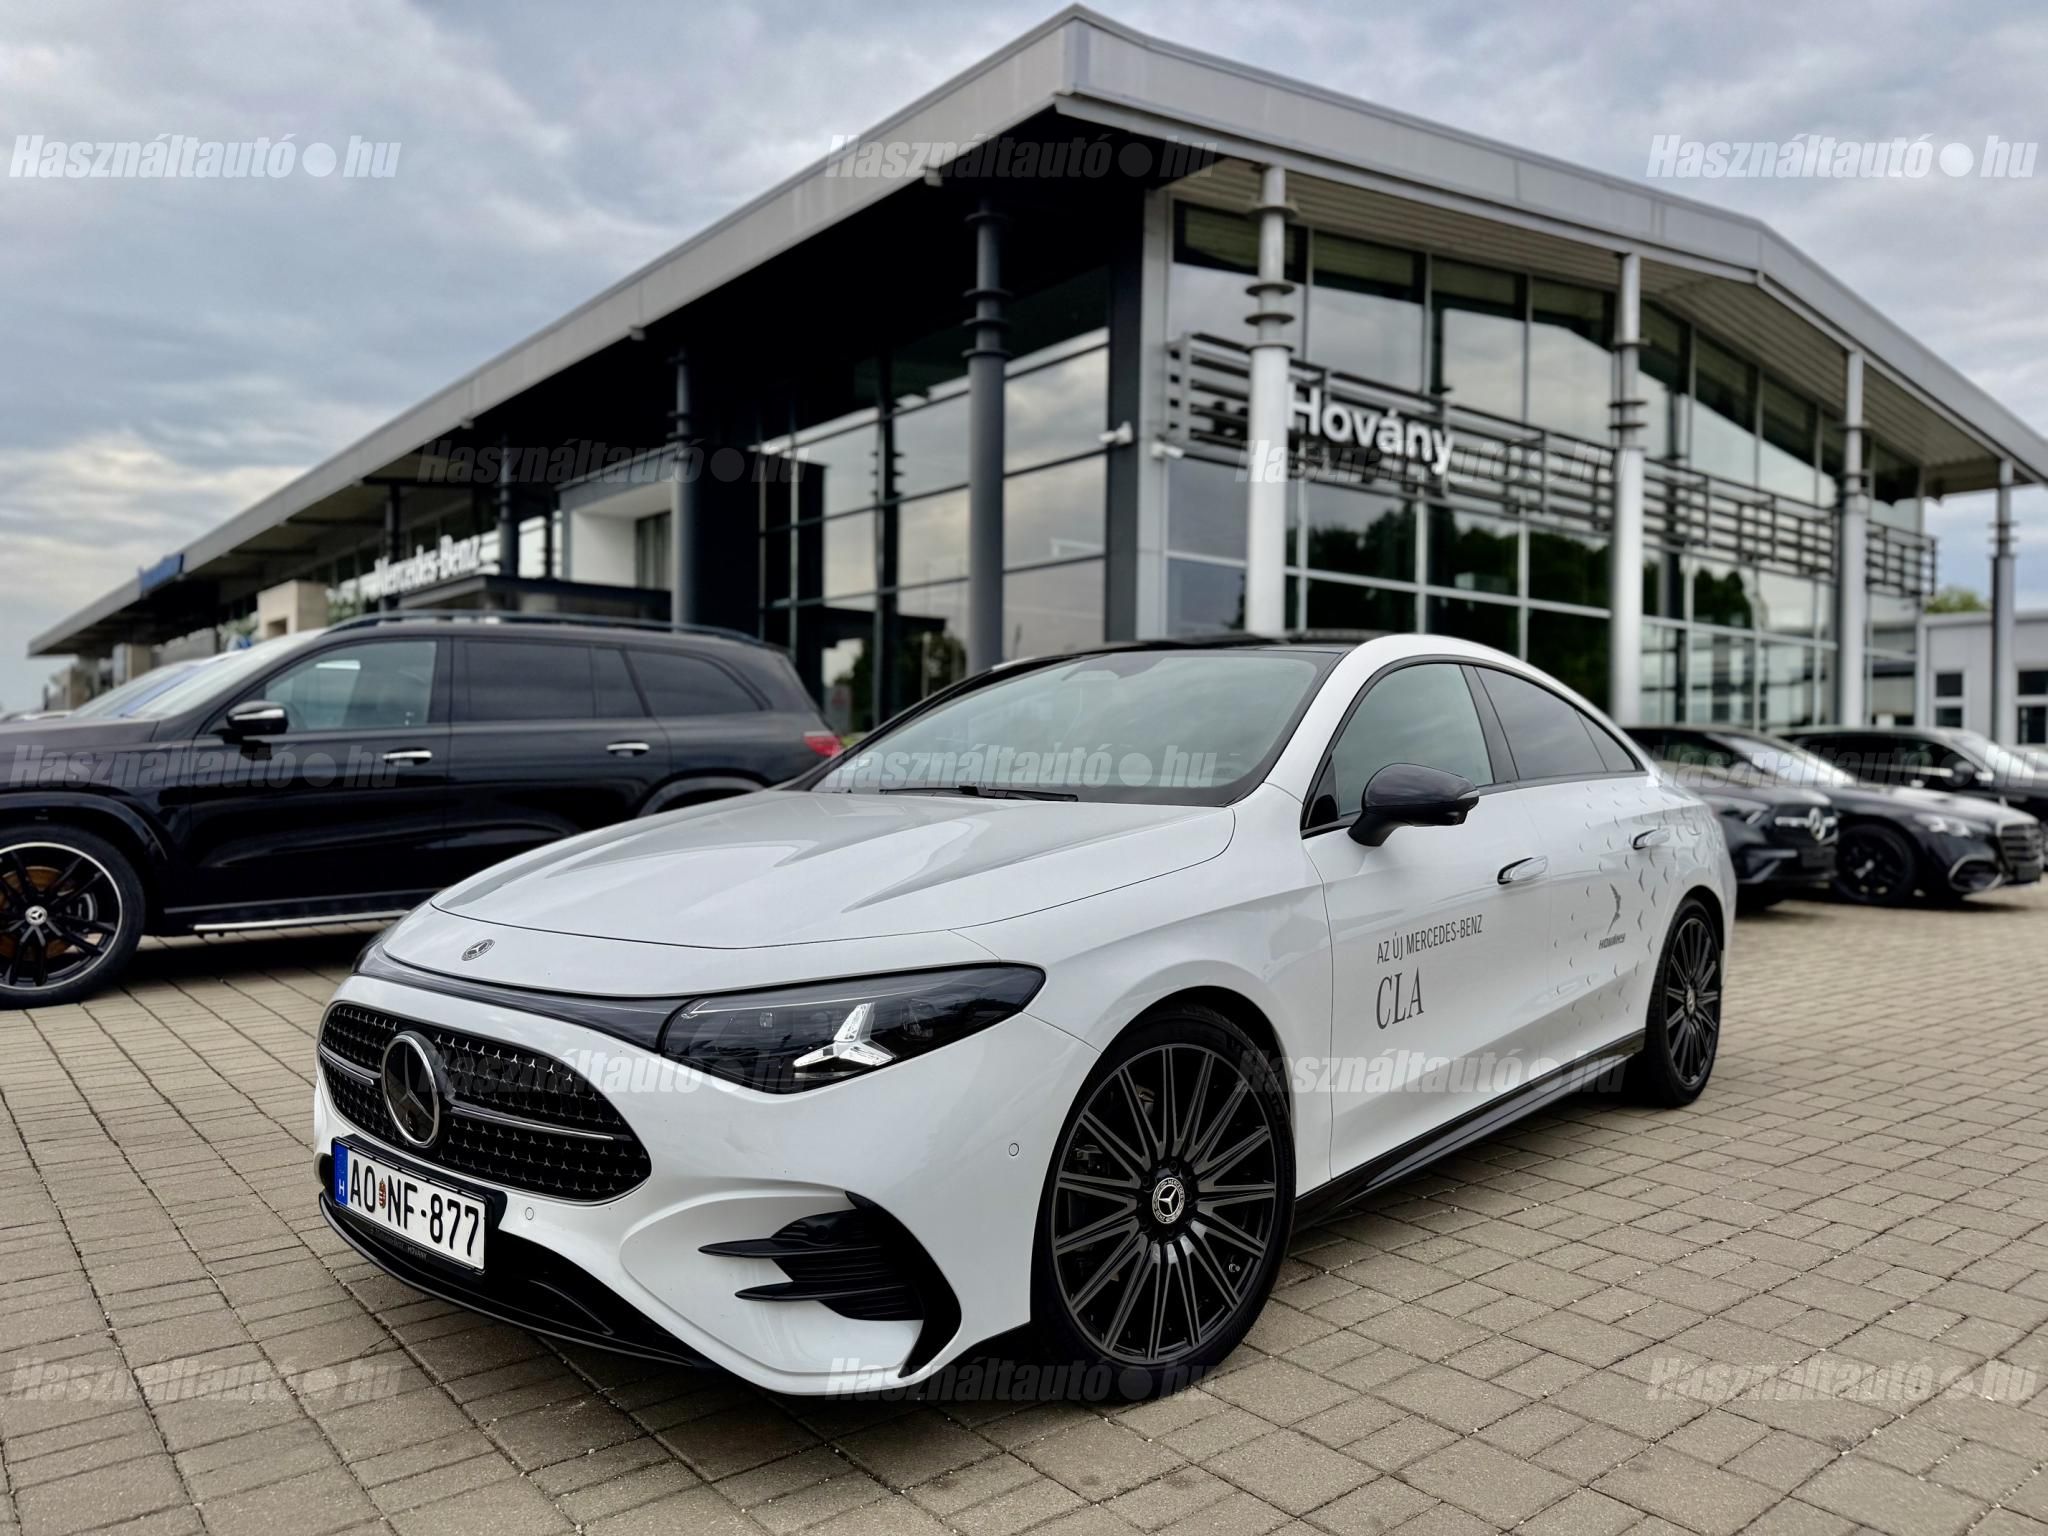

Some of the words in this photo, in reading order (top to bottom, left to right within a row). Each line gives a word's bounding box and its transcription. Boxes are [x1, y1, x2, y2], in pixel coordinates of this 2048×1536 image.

[1287, 382, 1455, 476] Hovány
[1377, 942, 1390, 964] AZ
[1392, 931, 1403, 961] ÚJ
[1406, 914, 1482, 955] MERCEDES-BENZ
[1376, 967, 1424, 1029] CLA
[338, 1180, 346, 1197] H
